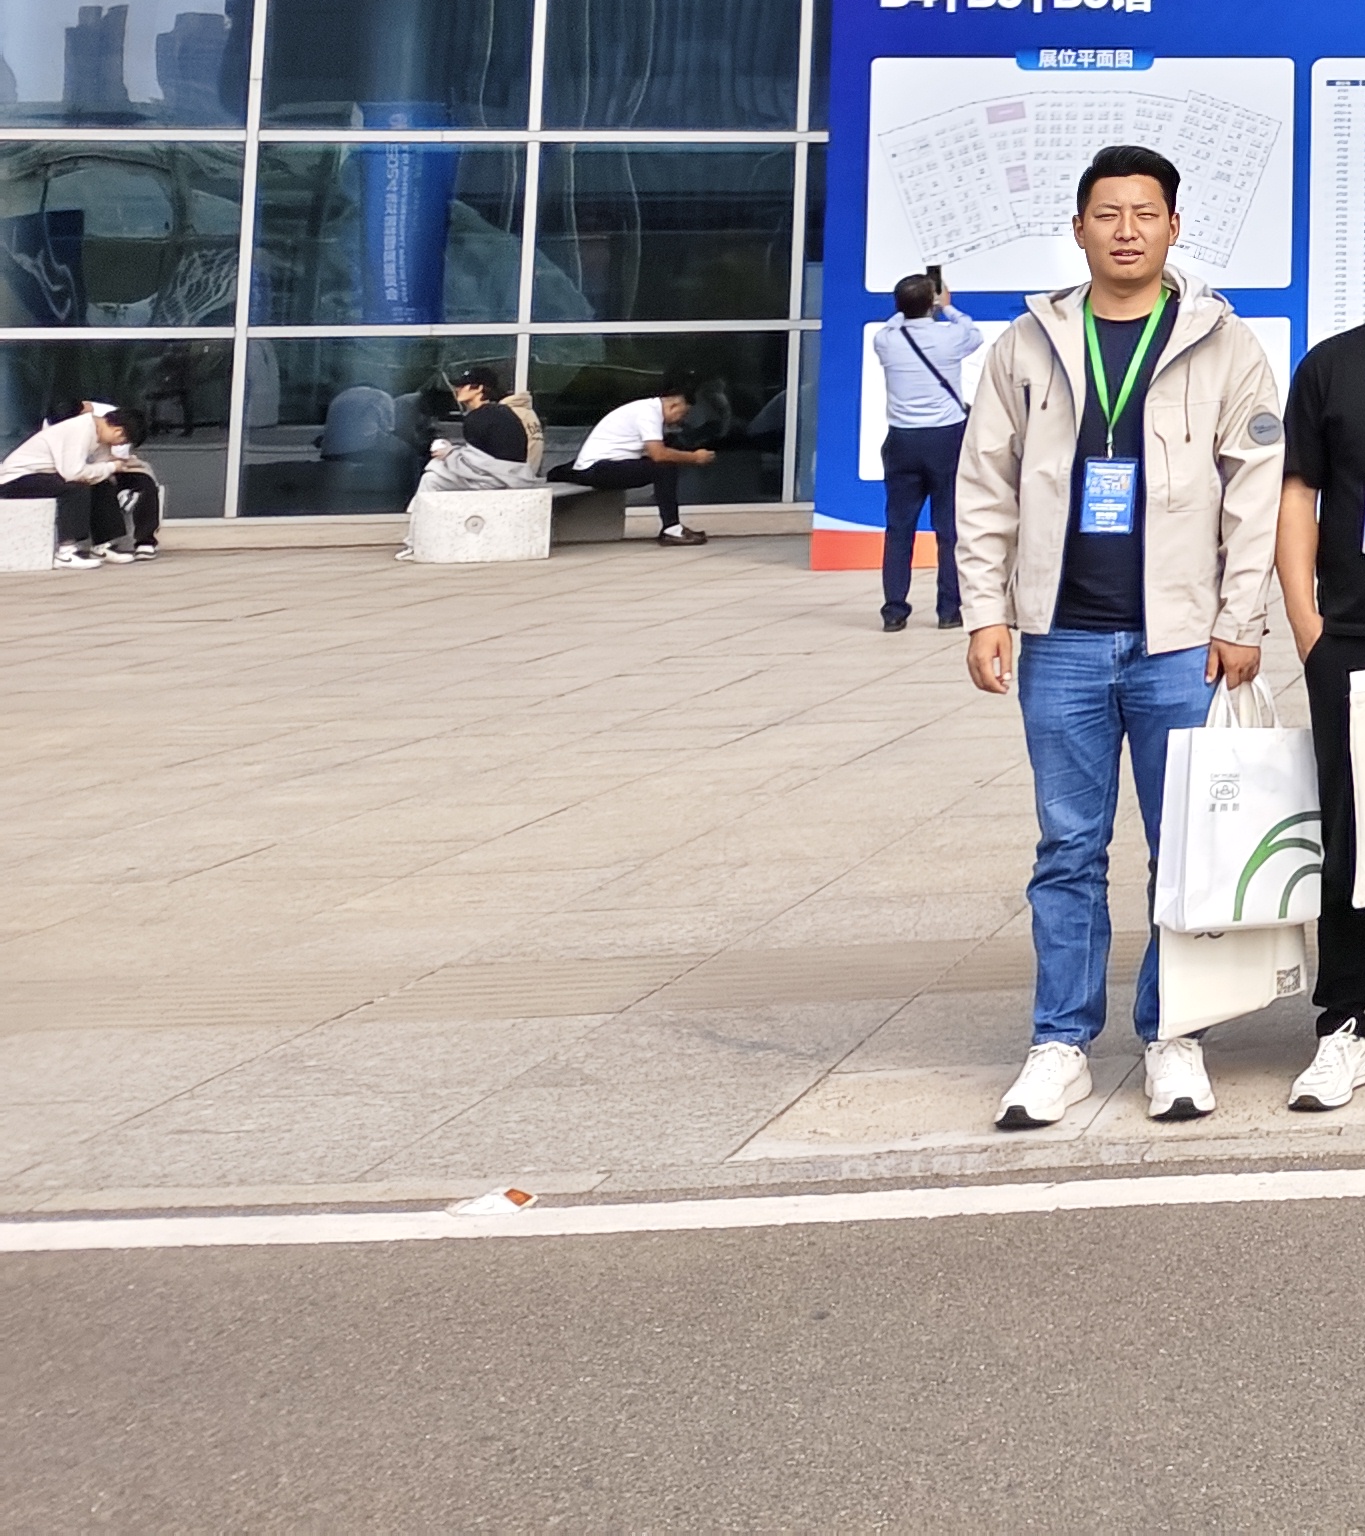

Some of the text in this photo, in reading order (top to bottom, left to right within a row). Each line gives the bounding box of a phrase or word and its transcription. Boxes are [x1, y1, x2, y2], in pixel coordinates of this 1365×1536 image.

[1038, 48, 1135, 69] 展位平面图
